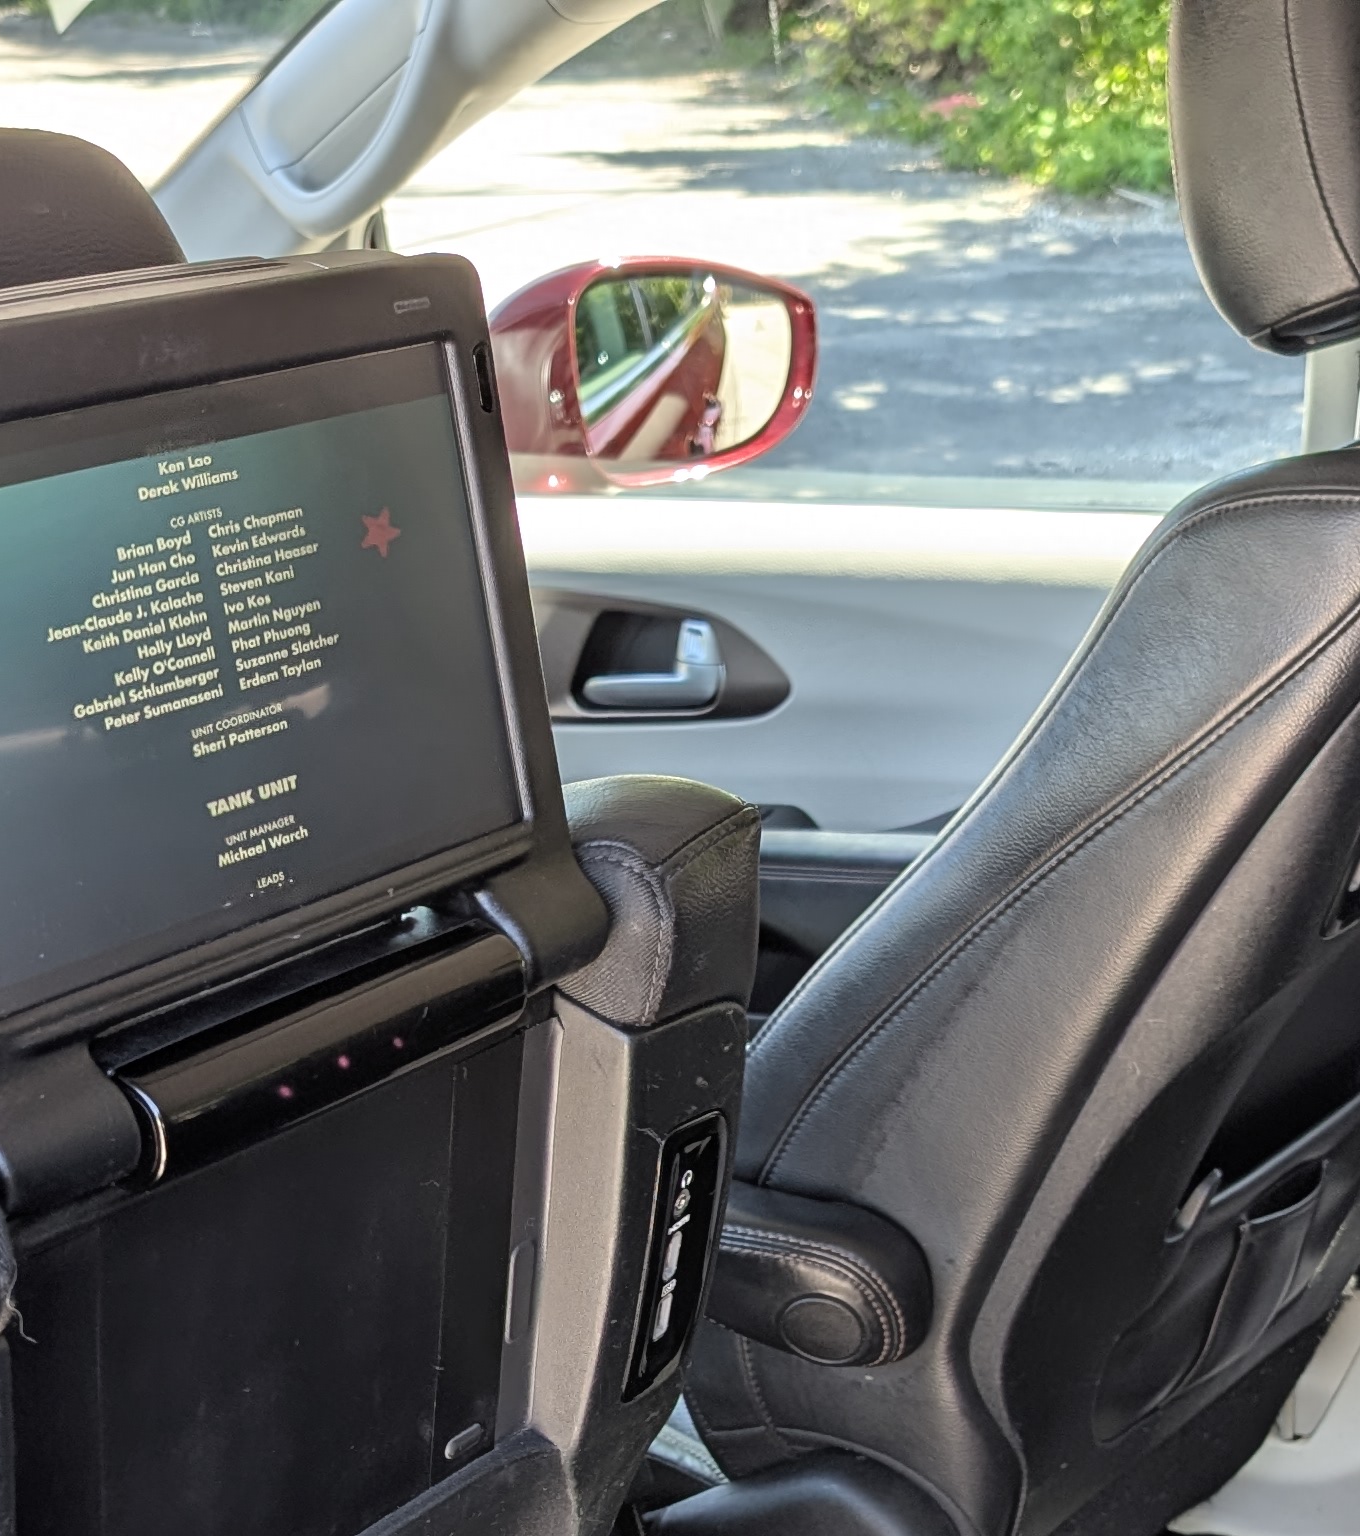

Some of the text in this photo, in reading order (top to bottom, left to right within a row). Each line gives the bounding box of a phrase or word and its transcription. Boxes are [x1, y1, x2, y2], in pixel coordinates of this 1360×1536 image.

[158, 454, 212, 476] Ken Lao
[138, 468, 238, 501] Derek Williams
[170, 507, 223, 529] CG ARTISTS
[208, 507, 303, 539] Chris Chapman
[116, 530, 192, 562] Brian Boyd
[212, 525, 306, 558] Kevin Edwards
[110, 550, 196, 585] Jun Han Cho
[216, 542, 319, 577] Christina Haaser
[92, 572, 200, 609] Christina Garcia
[220, 565, 295, 597] Steven Kani
[46, 591, 204, 643] Jean-Claude J. Kalache
[224, 594, 272, 616] Ivo Kos
[228, 599, 322, 635] Martin Nguyen
[82, 609, 208, 654] Keith Daniel Klohn
[137, 626, 212, 660] Holly Lloyd
[231, 622, 311, 654] Phat Phuong
[114, 646, 216, 687] Kelly O'Connell
[235, 632, 340, 672] Suzanne Slatcher
[239, 657, 322, 691] Erdem Taylan
[73, 667, 220, 719] Gabriel Schlumberger
[104, 683, 224, 731] Peter Sumanaseni
[191, 703, 283, 739] UNIT COORDINATOR
[192, 719, 289, 758] Sheri Patterson
[206, 774, 298, 817] TANK UNIT
[218, 825, 309, 868] Michael Warch
[225, 815, 295, 846] UNIT MANAGER
[256, 871, 285, 889] LEADS
